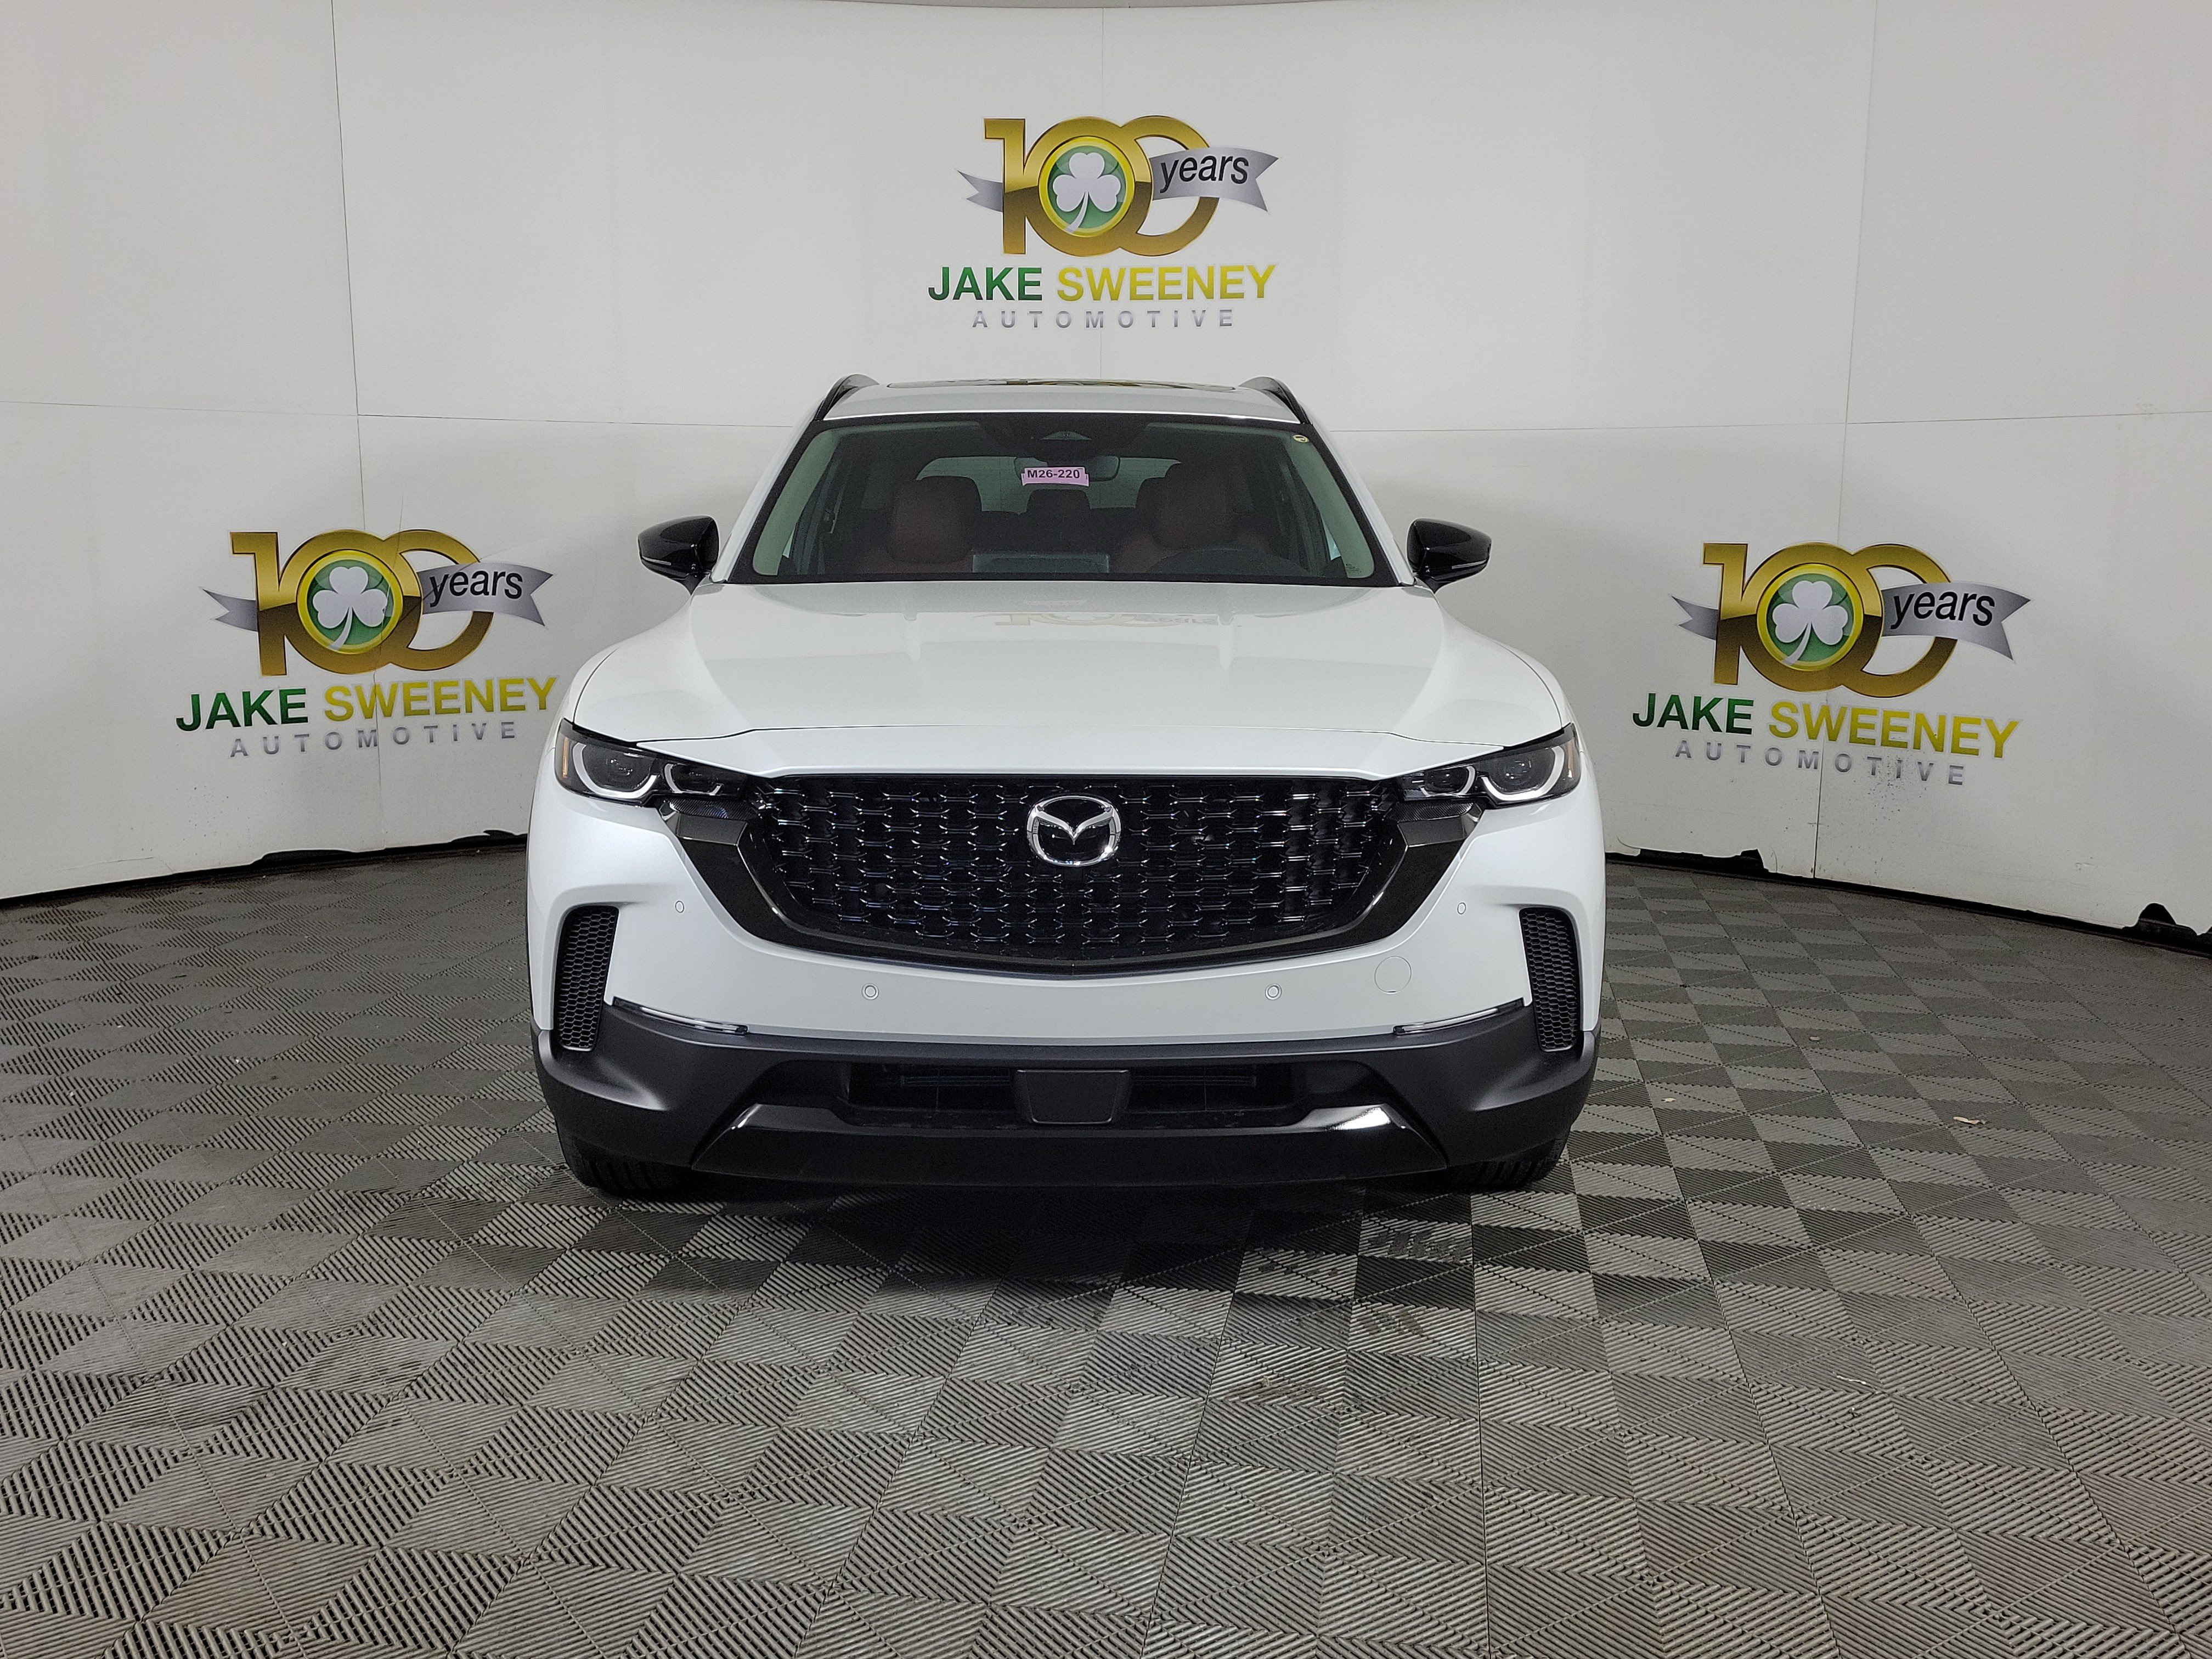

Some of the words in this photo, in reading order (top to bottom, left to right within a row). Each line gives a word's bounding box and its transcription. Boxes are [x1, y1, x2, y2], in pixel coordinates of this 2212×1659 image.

[984, 115, 1219, 257] 100
[1159, 154, 1250, 193] years
[928, 266, 1042, 301] JAKE
[1057, 264, 1277, 301] SWEENEY
[972, 309, 1233, 329] AUTOMOTIVE
[1027, 470, 1080, 479] M26-220
[229, 529, 494, 676] 100
[429, 569, 523, 607] years
[1702, 542, 1957, 698] 100
[1889, 590, 1995, 630] years
[176, 687, 308, 732] JAKE
[324, 676, 557, 722] SWEENEY
[1632, 692, 1754, 735] JAKE
[1768, 701, 2019, 759] SWEENEY
[230, 721, 515, 758] AUTOMOTIVE
[1675, 740, 1964, 786] AUTOMOTIVE
